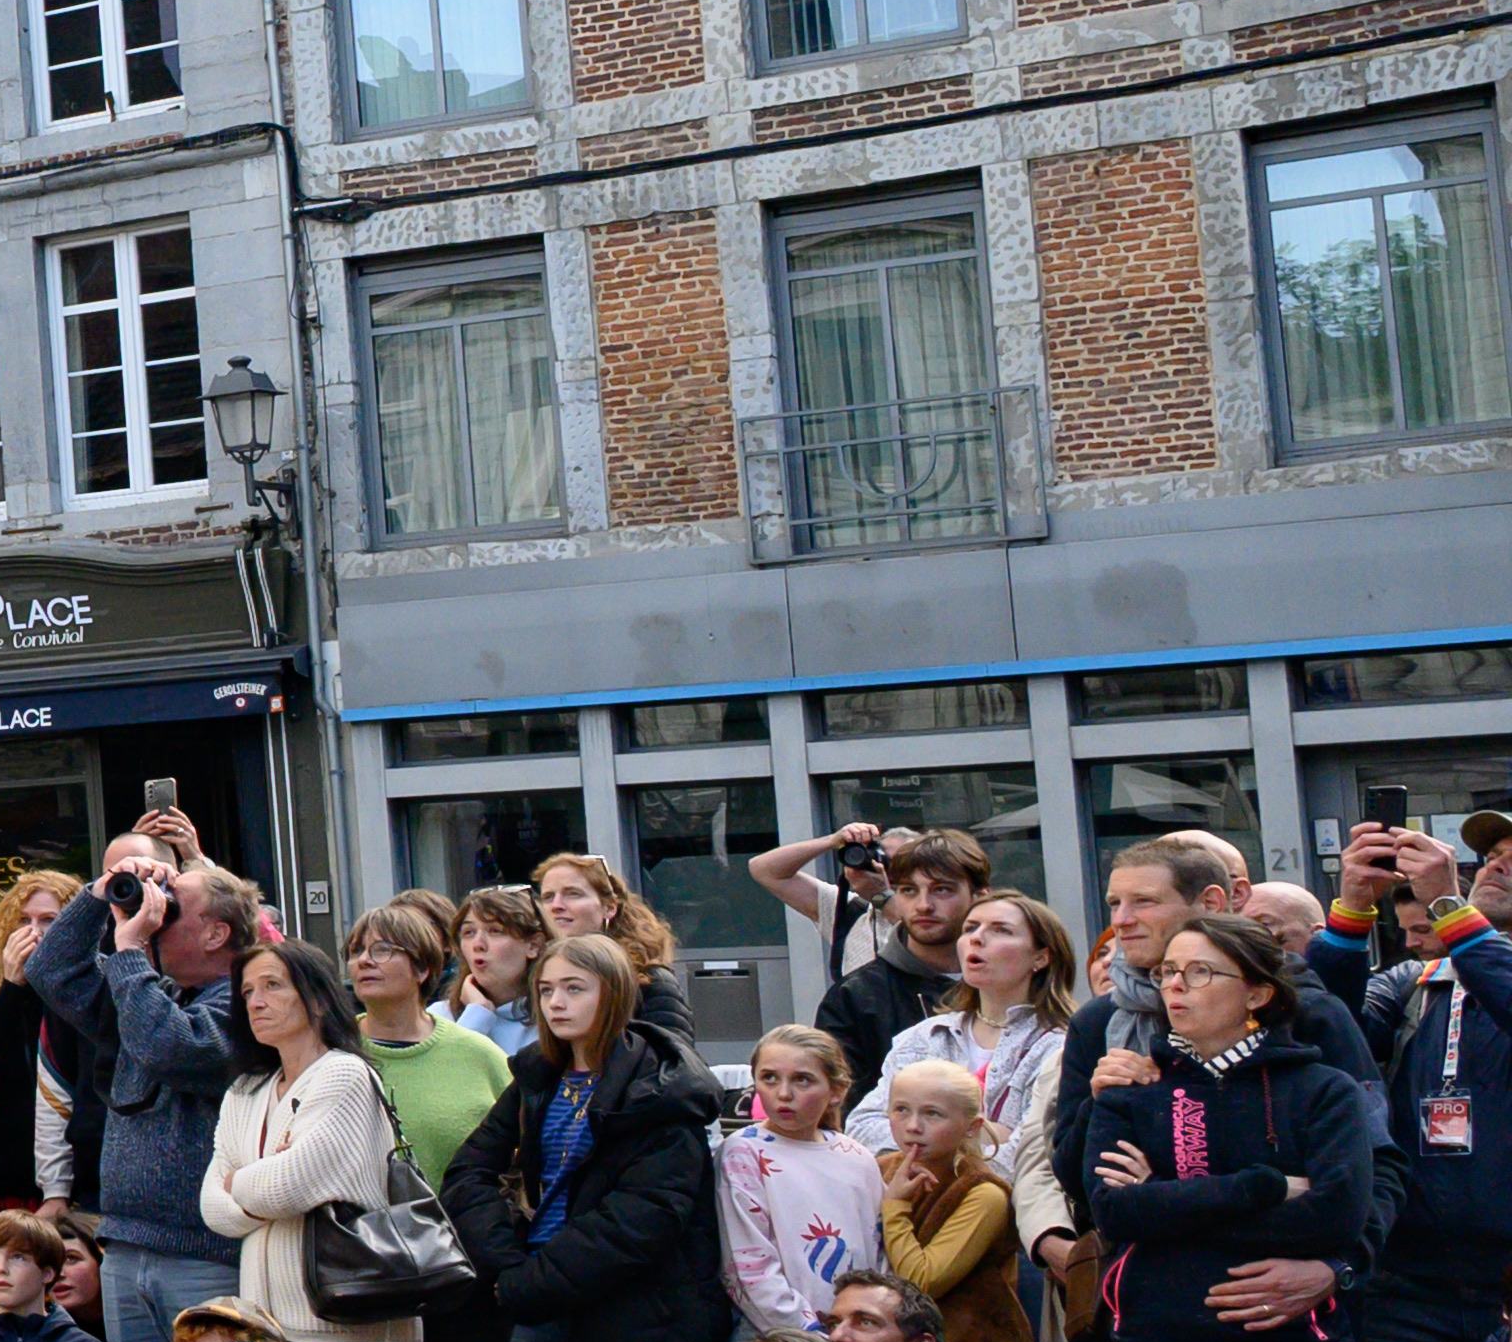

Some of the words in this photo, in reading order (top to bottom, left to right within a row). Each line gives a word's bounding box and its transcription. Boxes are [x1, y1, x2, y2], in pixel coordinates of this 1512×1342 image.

[12, 625, 84, 649] Convivial
[1270, 848, 1299, 872] 21
[309, 891, 326, 905] 20
[1433, 1103, 1465, 1115] PRO
[1172, 1101, 1190, 1180] EOGRAPHICAL
[1183, 1098, 1210, 1177] ORWAY
